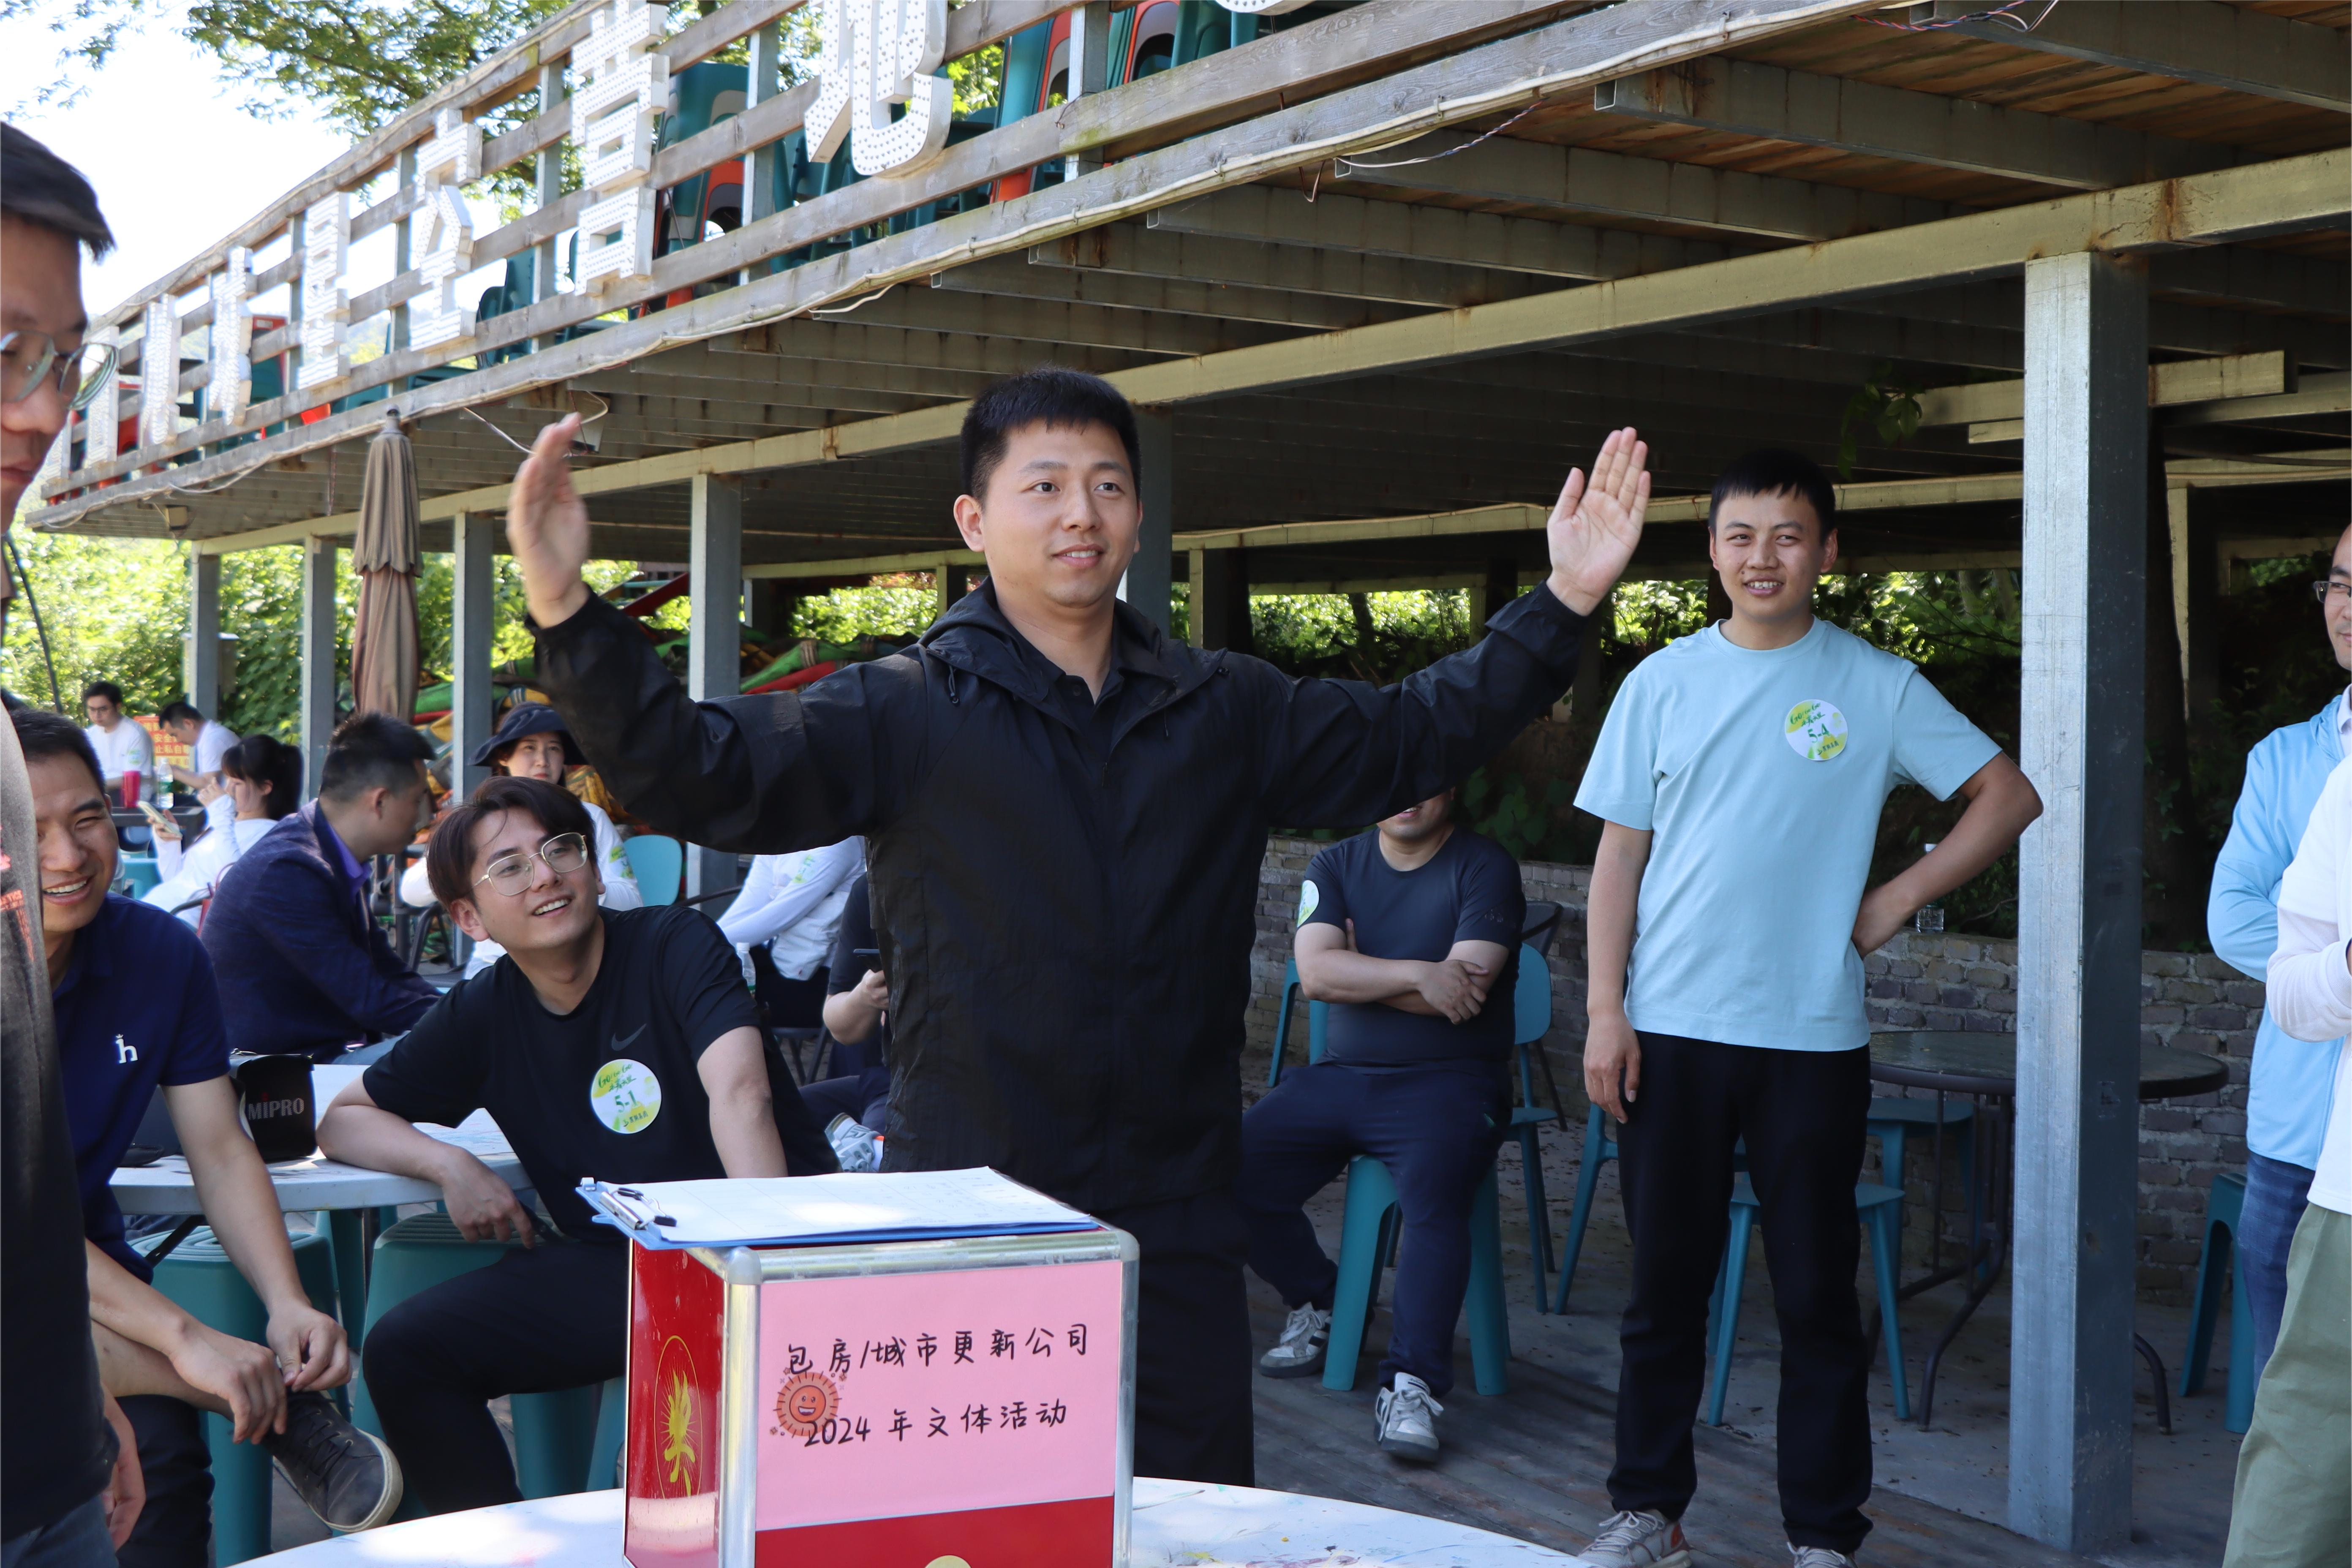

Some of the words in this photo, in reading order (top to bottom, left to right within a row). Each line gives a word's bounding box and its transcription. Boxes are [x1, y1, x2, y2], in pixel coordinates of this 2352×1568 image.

[1807, 723, 1830, 743] 5-4
[248, 1097, 305, 1120] MIPRO
[614, 1090, 640, 1113] 5-1
